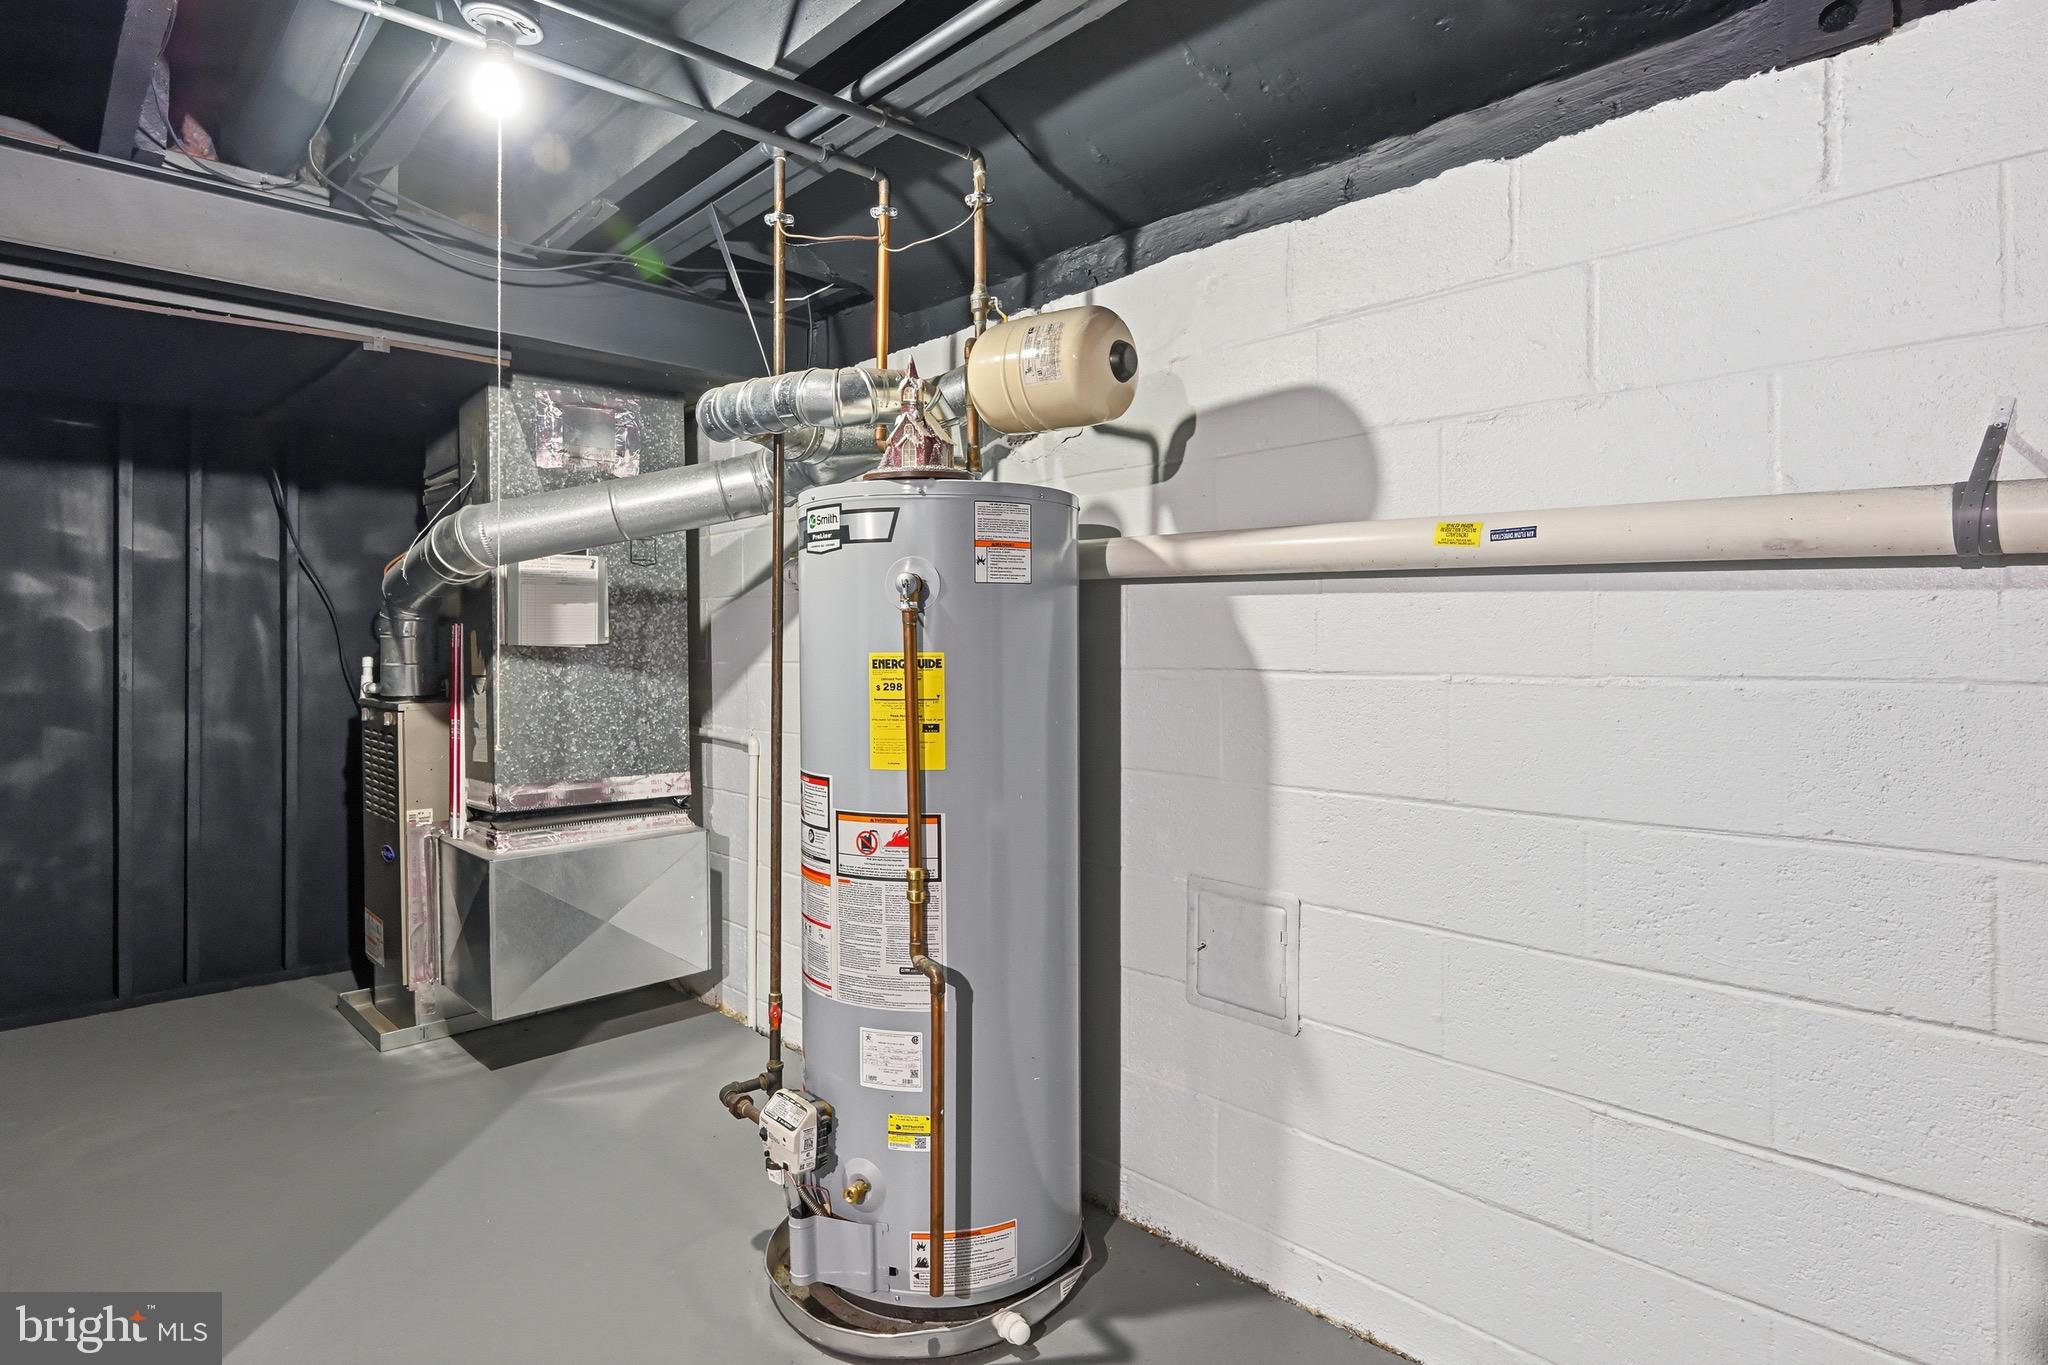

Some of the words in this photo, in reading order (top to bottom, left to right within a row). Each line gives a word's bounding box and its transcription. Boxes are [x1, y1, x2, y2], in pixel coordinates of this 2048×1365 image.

[816, 513, 838, 525] Smith
[872, 658, 942, 669] ENERGUIDE
[883, 682, 903, 691] 298
